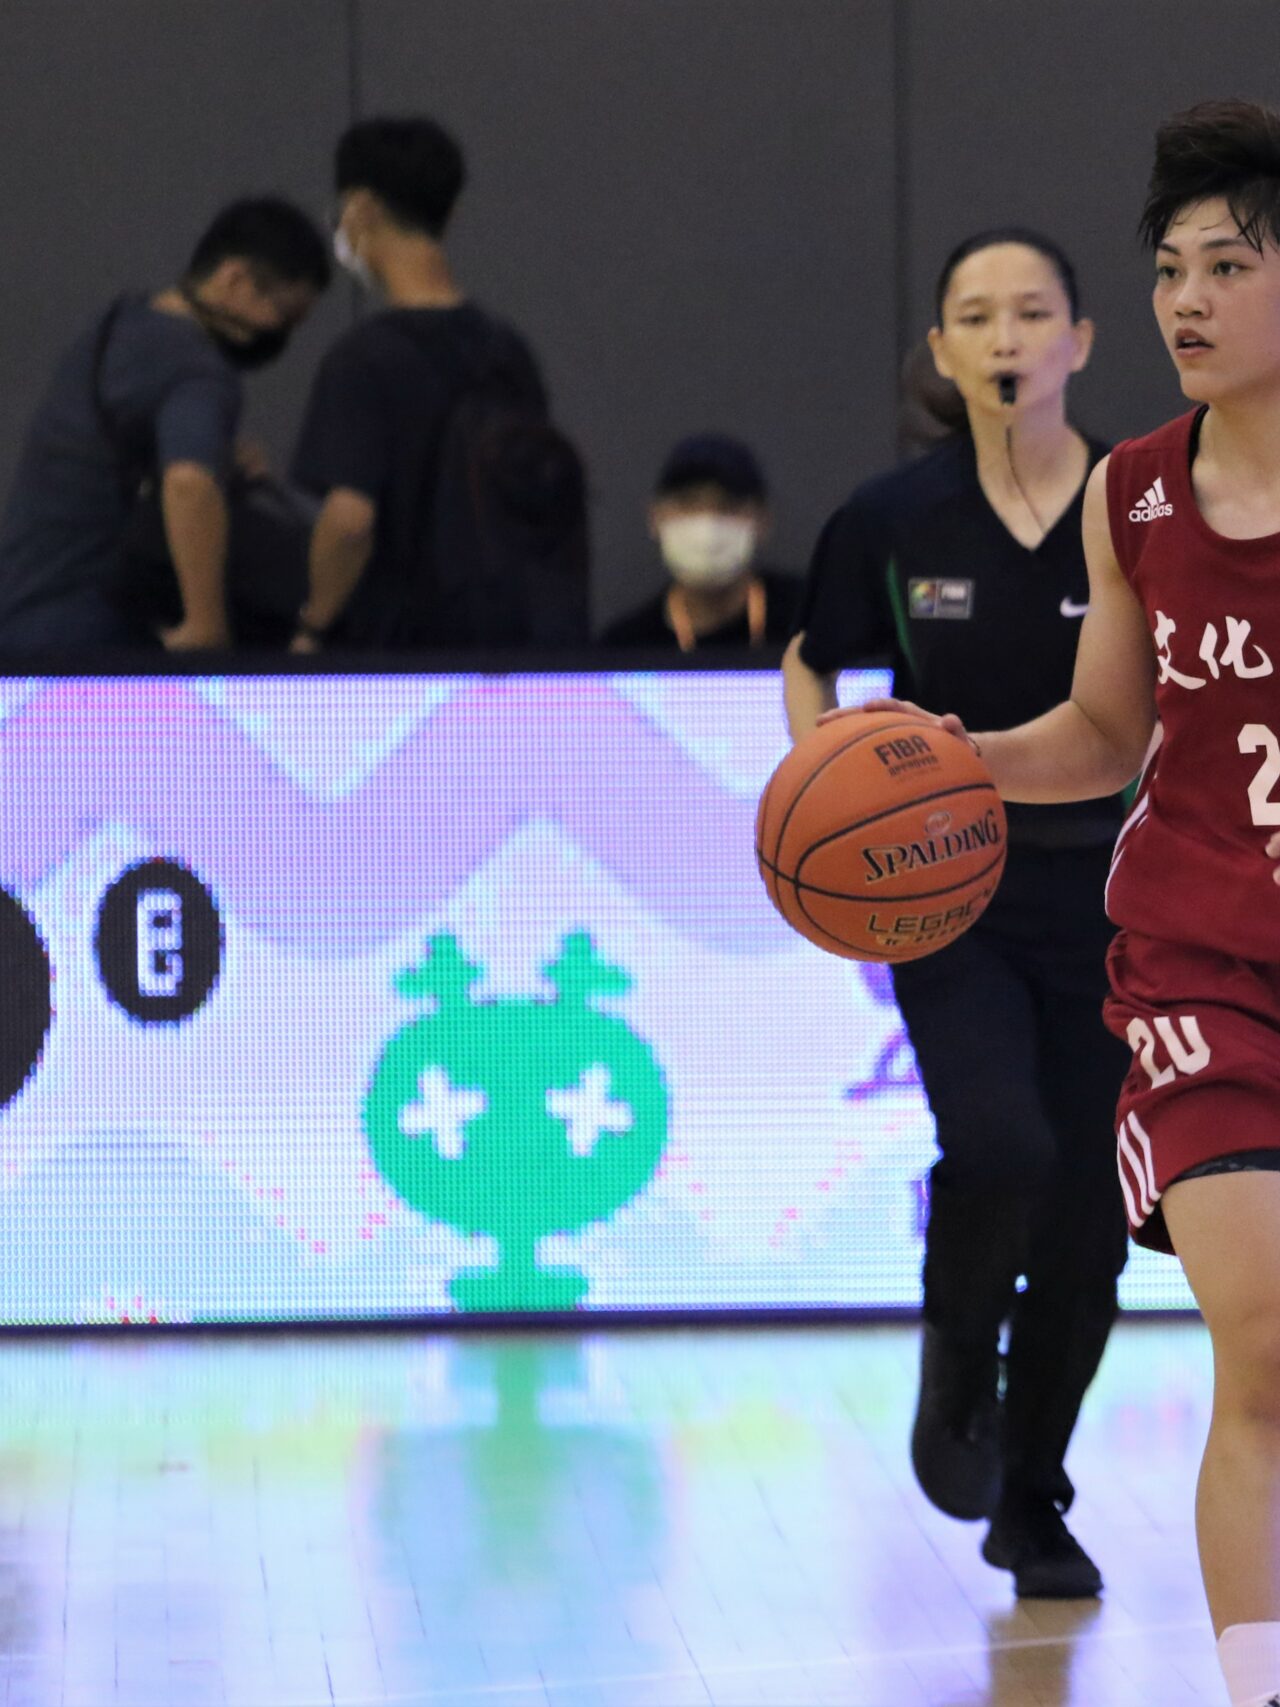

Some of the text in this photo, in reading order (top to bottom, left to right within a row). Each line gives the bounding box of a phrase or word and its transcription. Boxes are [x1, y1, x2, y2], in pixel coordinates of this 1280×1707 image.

[1128, 503, 1174, 523] adidas
[873, 734, 932, 766] FIBA
[861, 807, 1000, 885] SPALDING
